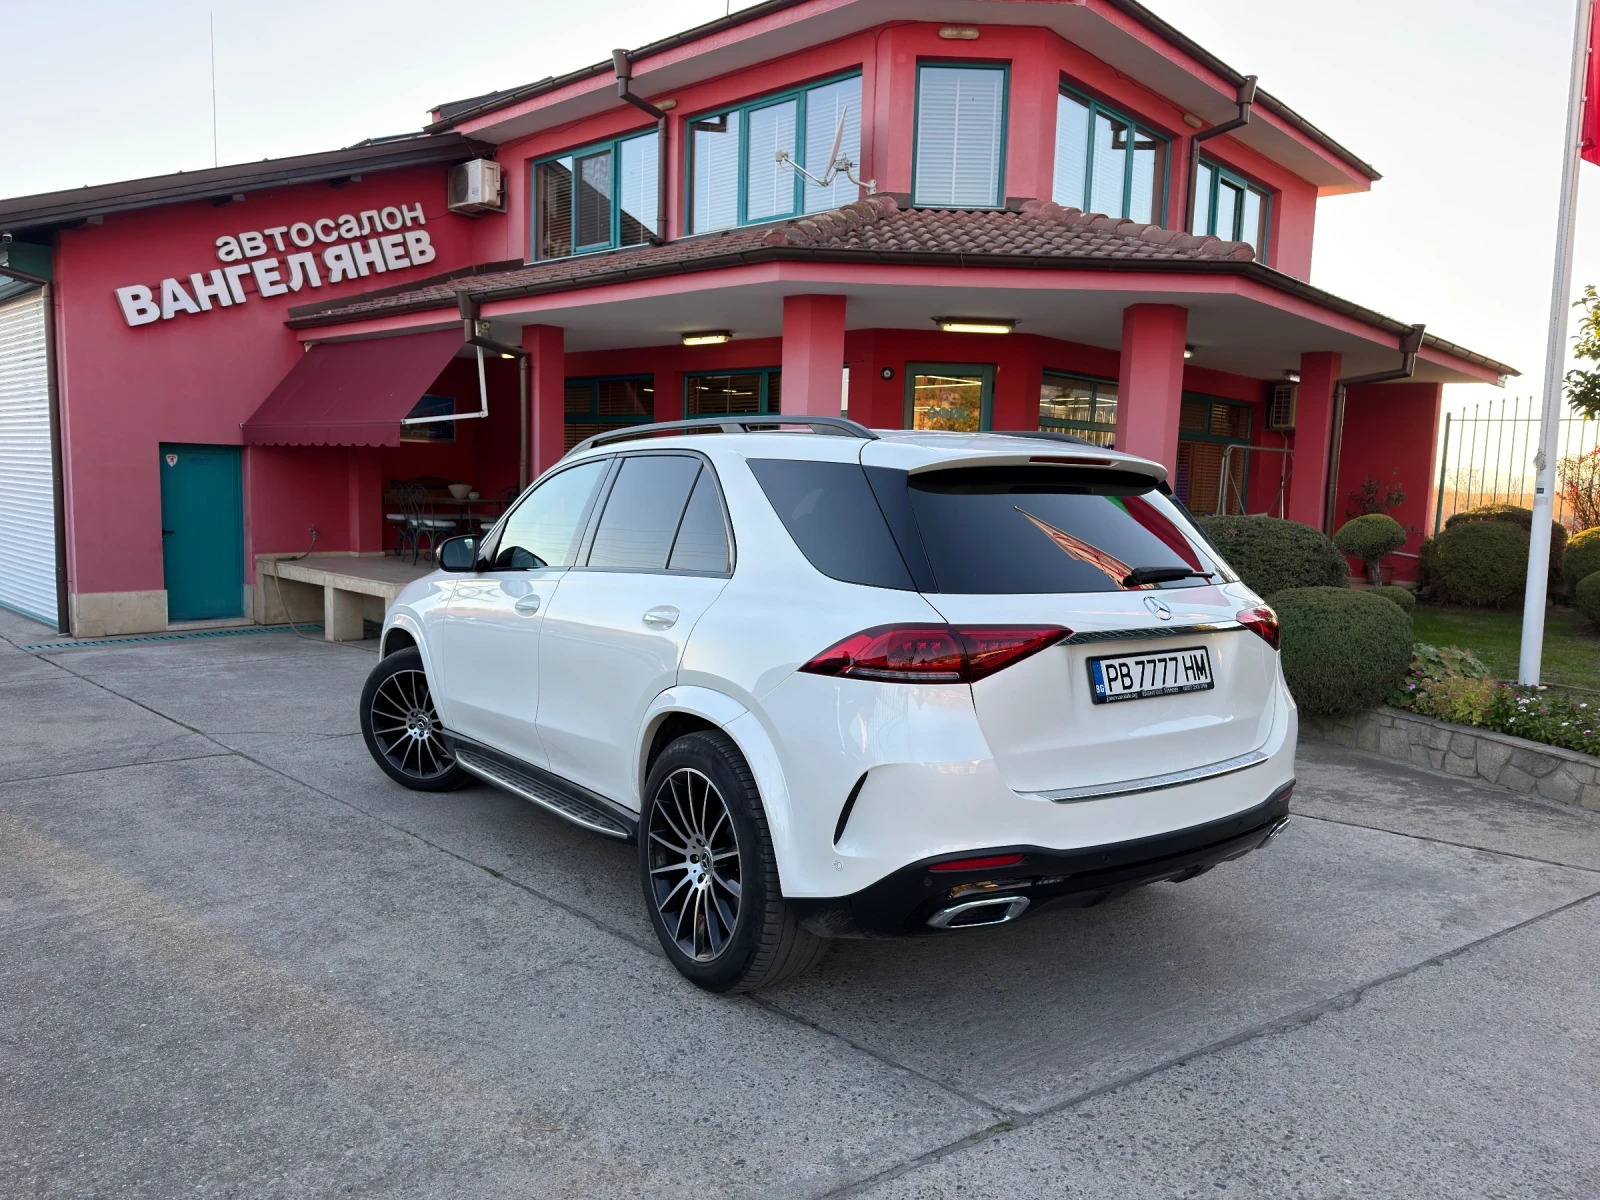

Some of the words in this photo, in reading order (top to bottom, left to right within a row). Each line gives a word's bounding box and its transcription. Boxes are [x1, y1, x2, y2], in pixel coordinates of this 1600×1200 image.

[214, 202, 426, 263] автосалон
[113, 251, 322, 327] ВАНГЕЛ
[322, 230, 436, 283] ЯНЕВ
